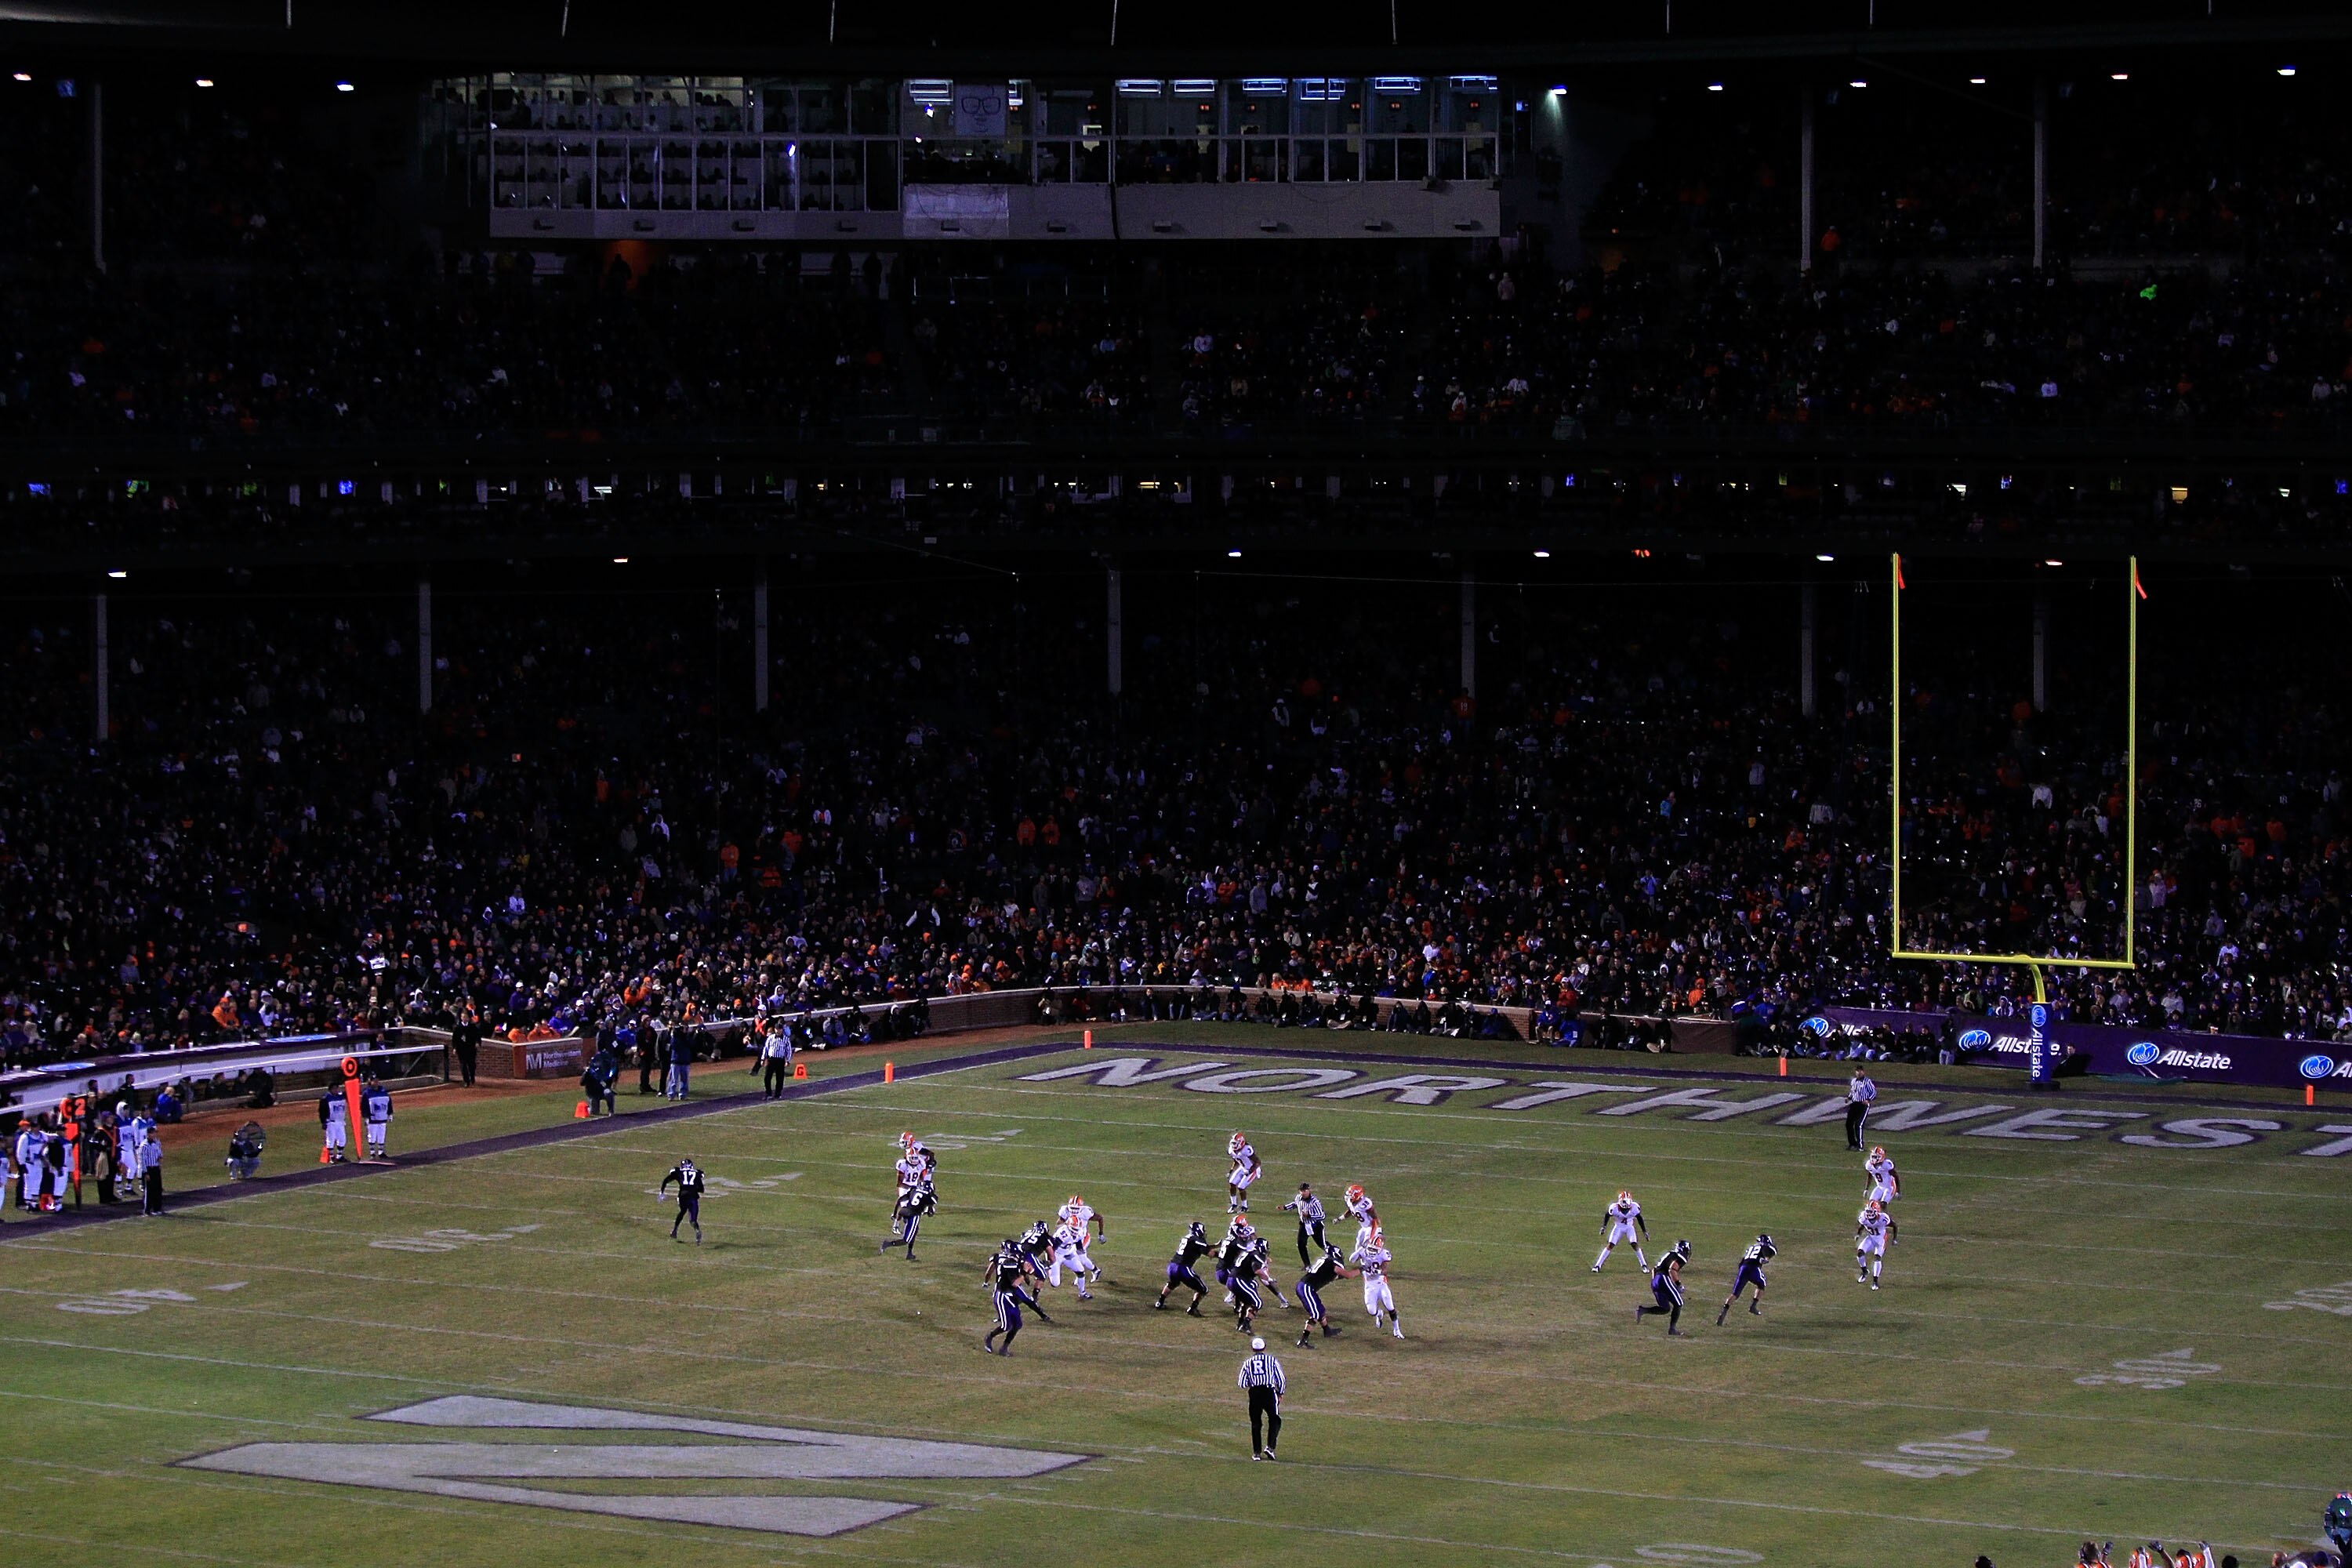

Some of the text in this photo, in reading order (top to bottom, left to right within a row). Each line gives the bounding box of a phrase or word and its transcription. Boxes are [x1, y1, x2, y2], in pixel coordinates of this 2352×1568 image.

[797, 1066, 804, 1076] G
[682, 1171, 697, 1185] 17
[910, 1192, 924, 1206] 6
[1252, 1359, 1265, 1374] R
